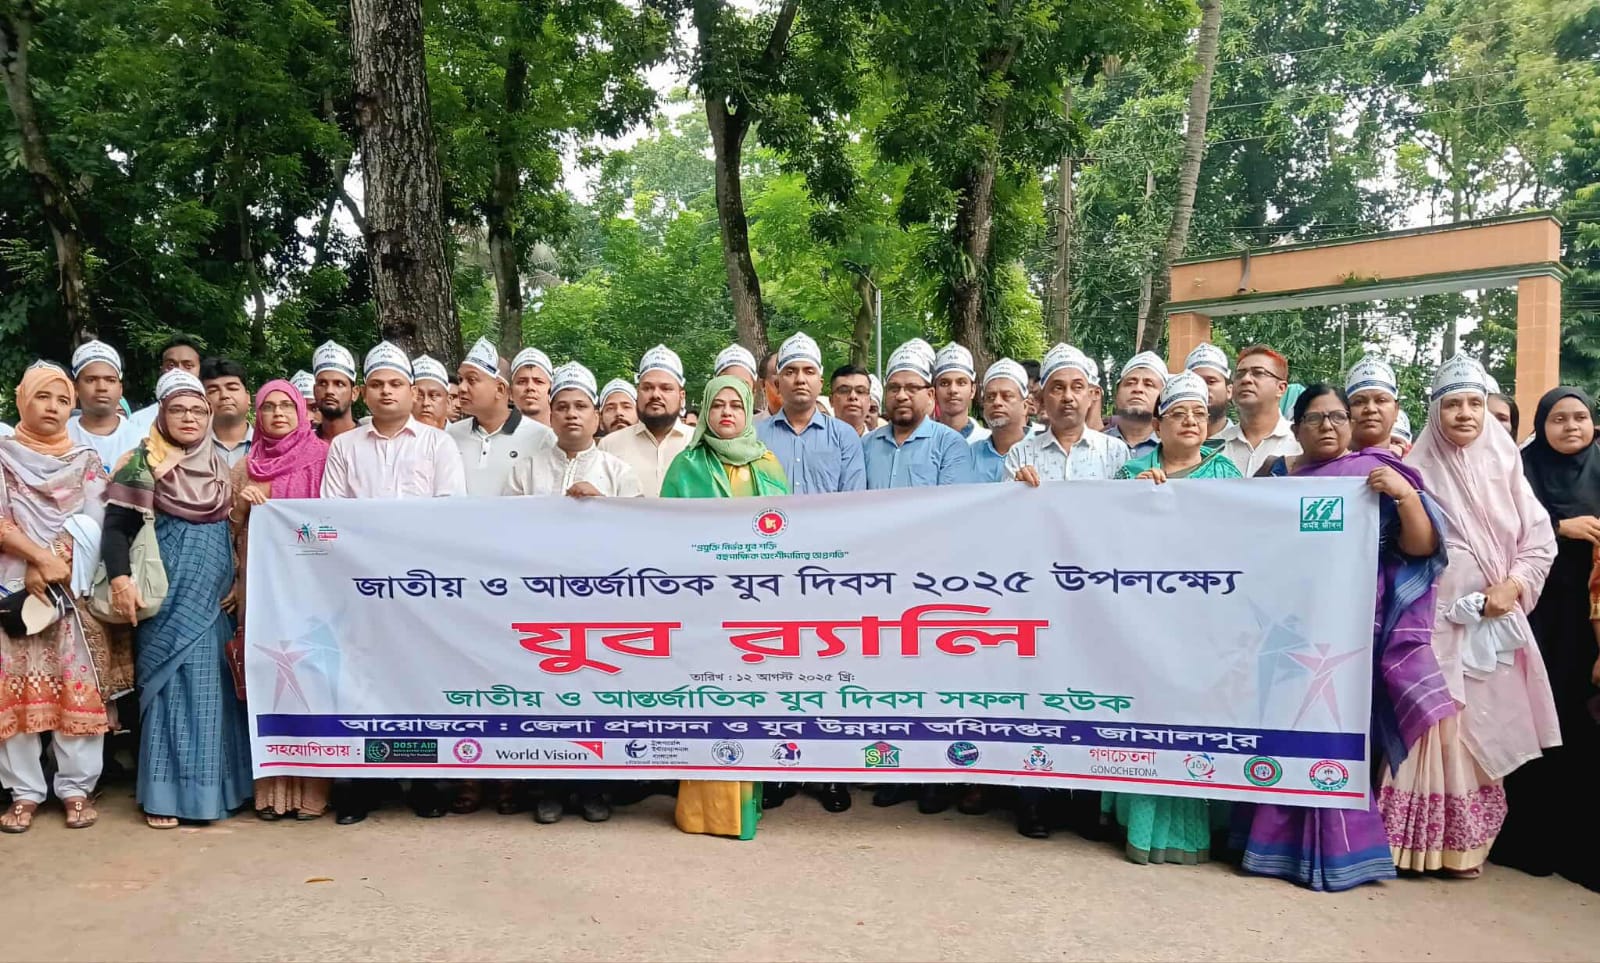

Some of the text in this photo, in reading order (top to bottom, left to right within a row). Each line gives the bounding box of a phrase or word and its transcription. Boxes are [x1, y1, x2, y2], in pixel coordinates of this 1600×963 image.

[352, 561, 1244, 602] জাতীয় ও আন্তর্জাতিক যুব দিবস ২০২৫ উপলক্ষ্যে
[511, 604, 1049, 675] যুব র‍্যালি
[689, 672, 724, 682] তারিখ
[737, 673, 753, 683] ১২
[756, 671, 794, 682] আগস্ট
[799, 673, 833, 683] ২০২৫
[443, 684, 1135, 713] জাতীয় ও আন্তর্জাতিক যুব দিবস সফল হউক
[339, 718, 489, 733] আয়োজনে
[519, 719, 597, 733] জেলা
[604, 719, 713, 734] প্রশাসন
[722, 721, 749, 733] ও
[757, 720, 807, 737] যুব
[814, 716, 914, 736] উন্নয়ন
[1092, 726, 1263, 751] জামালপুর
[266, 741, 352, 757] সহযোগিতায়
[495, 749, 539, 760] World
[543, 749, 589, 760] Vision
[1089, 748, 1157, 765] গণচেতনা
[1090, 765, 1158, 777] GONOCHETONA
